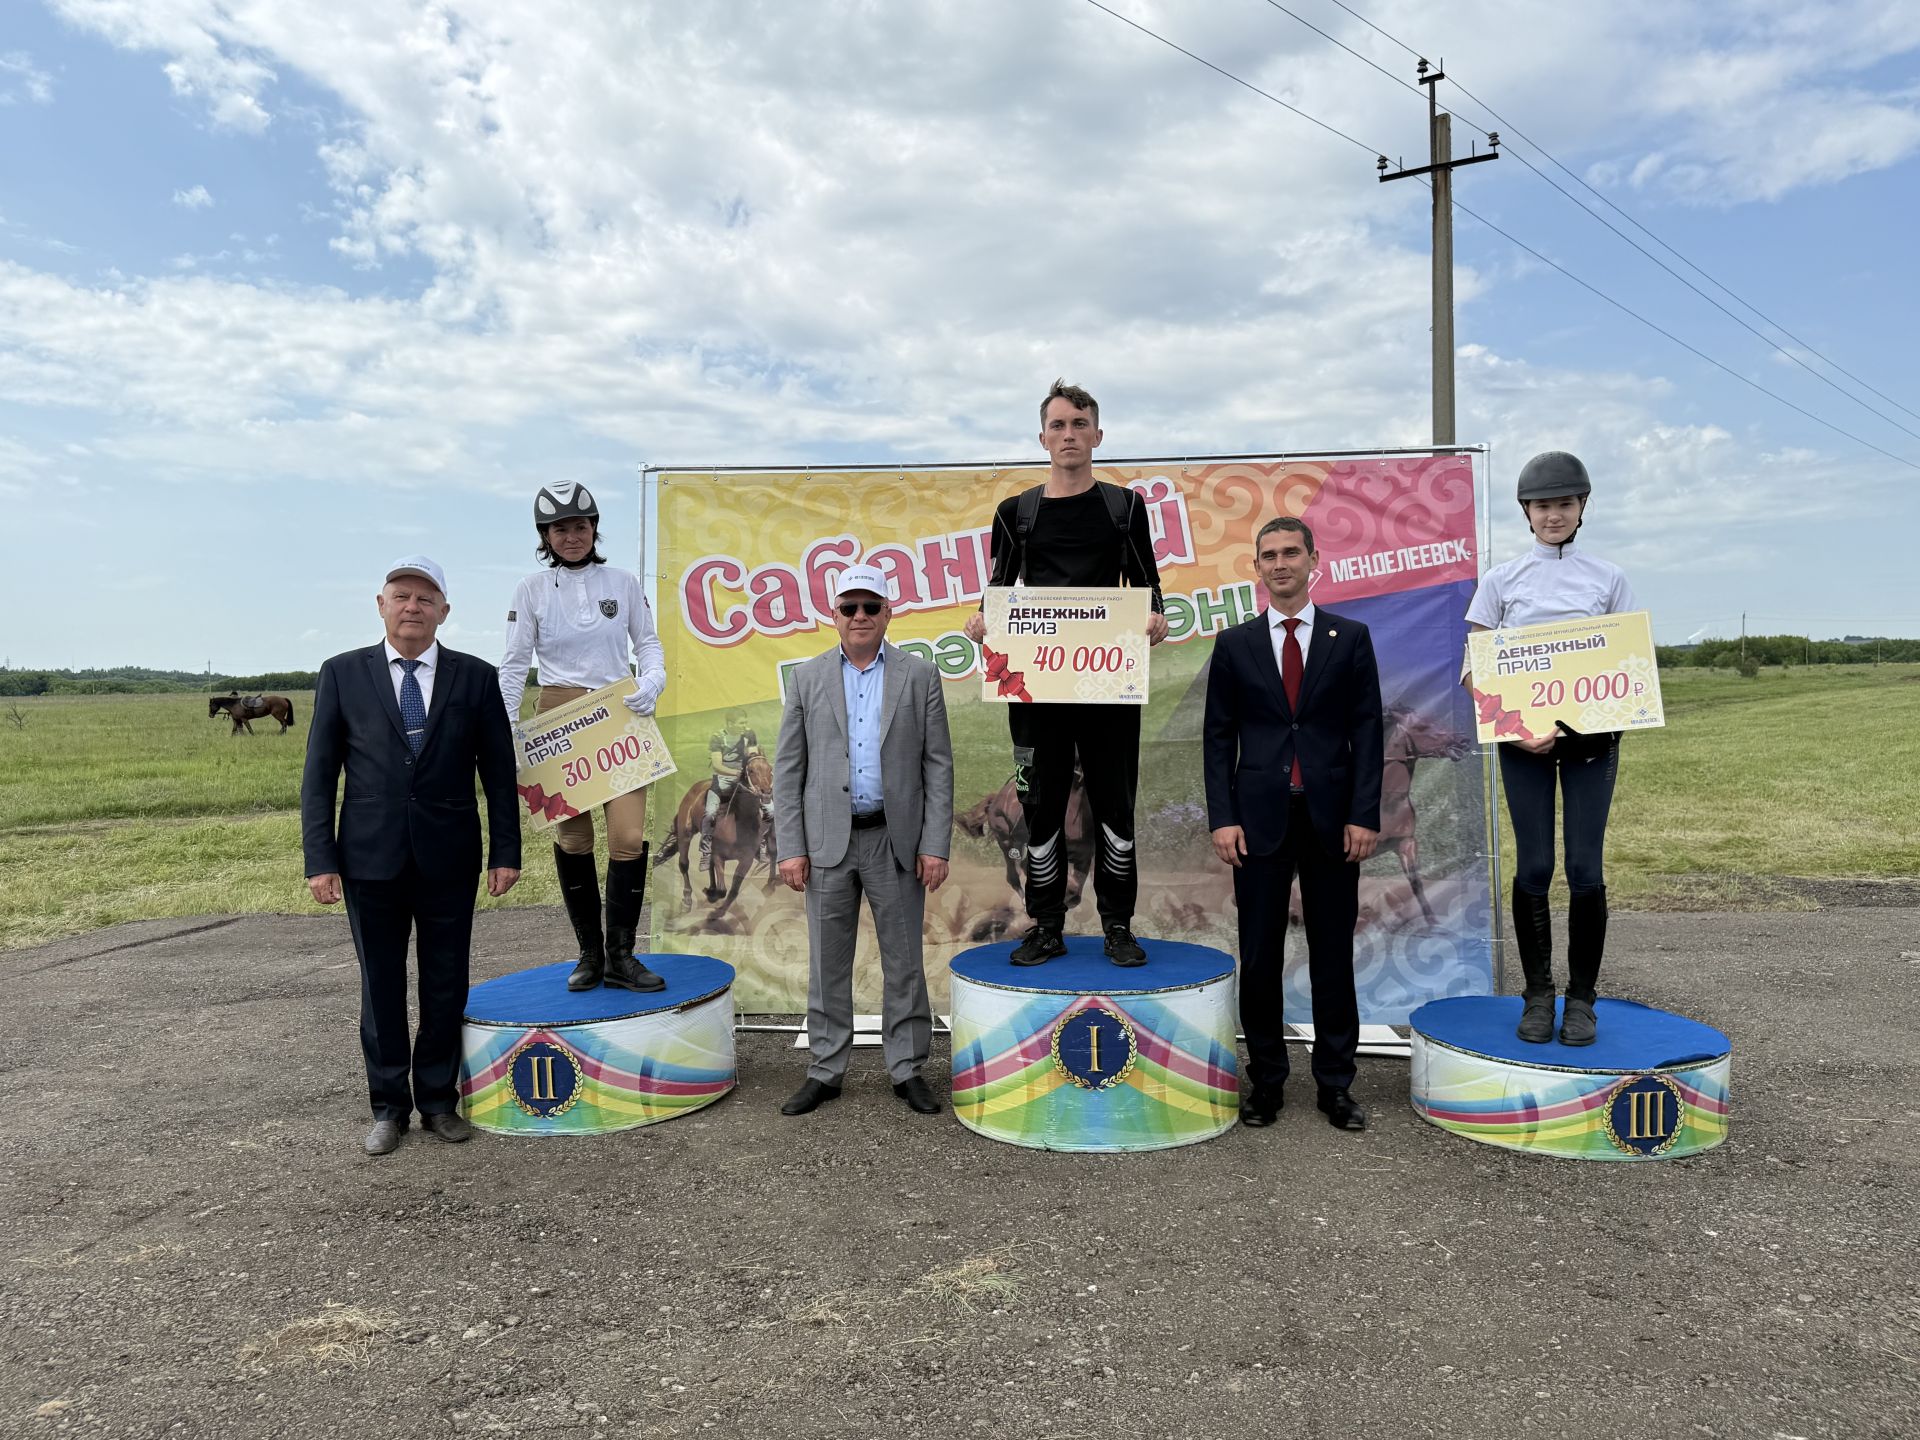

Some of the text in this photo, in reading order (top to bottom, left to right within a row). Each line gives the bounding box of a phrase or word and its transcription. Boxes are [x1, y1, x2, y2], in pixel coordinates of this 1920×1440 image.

[1329, 537, 1470, 584] МЕНДЕЛЕЕВСК
[1008, 605, 1107, 621] ДЕНЕЖНЫЙ
[1008, 621, 1057, 635] ПРИЗ
[1032, 645, 1066, 672] 40
[1072, 645, 1123, 673] 000
[1496, 634, 1606, 660] ДЕНЕЖНЫЙ
[1497, 657, 1552, 676] ПРИЗ
[1530, 679, 1565, 708] 20
[1573, 671, 1631, 704] 000
[524, 706, 611, 753] ДЕНЕЖНЫЙ
[527, 738, 574, 766] ПРИЗ
[561, 756, 592, 788] 30
[596, 735, 641, 773] 000
[527, 1056, 559, 1100] II
[1626, 1090, 1668, 1139] III
